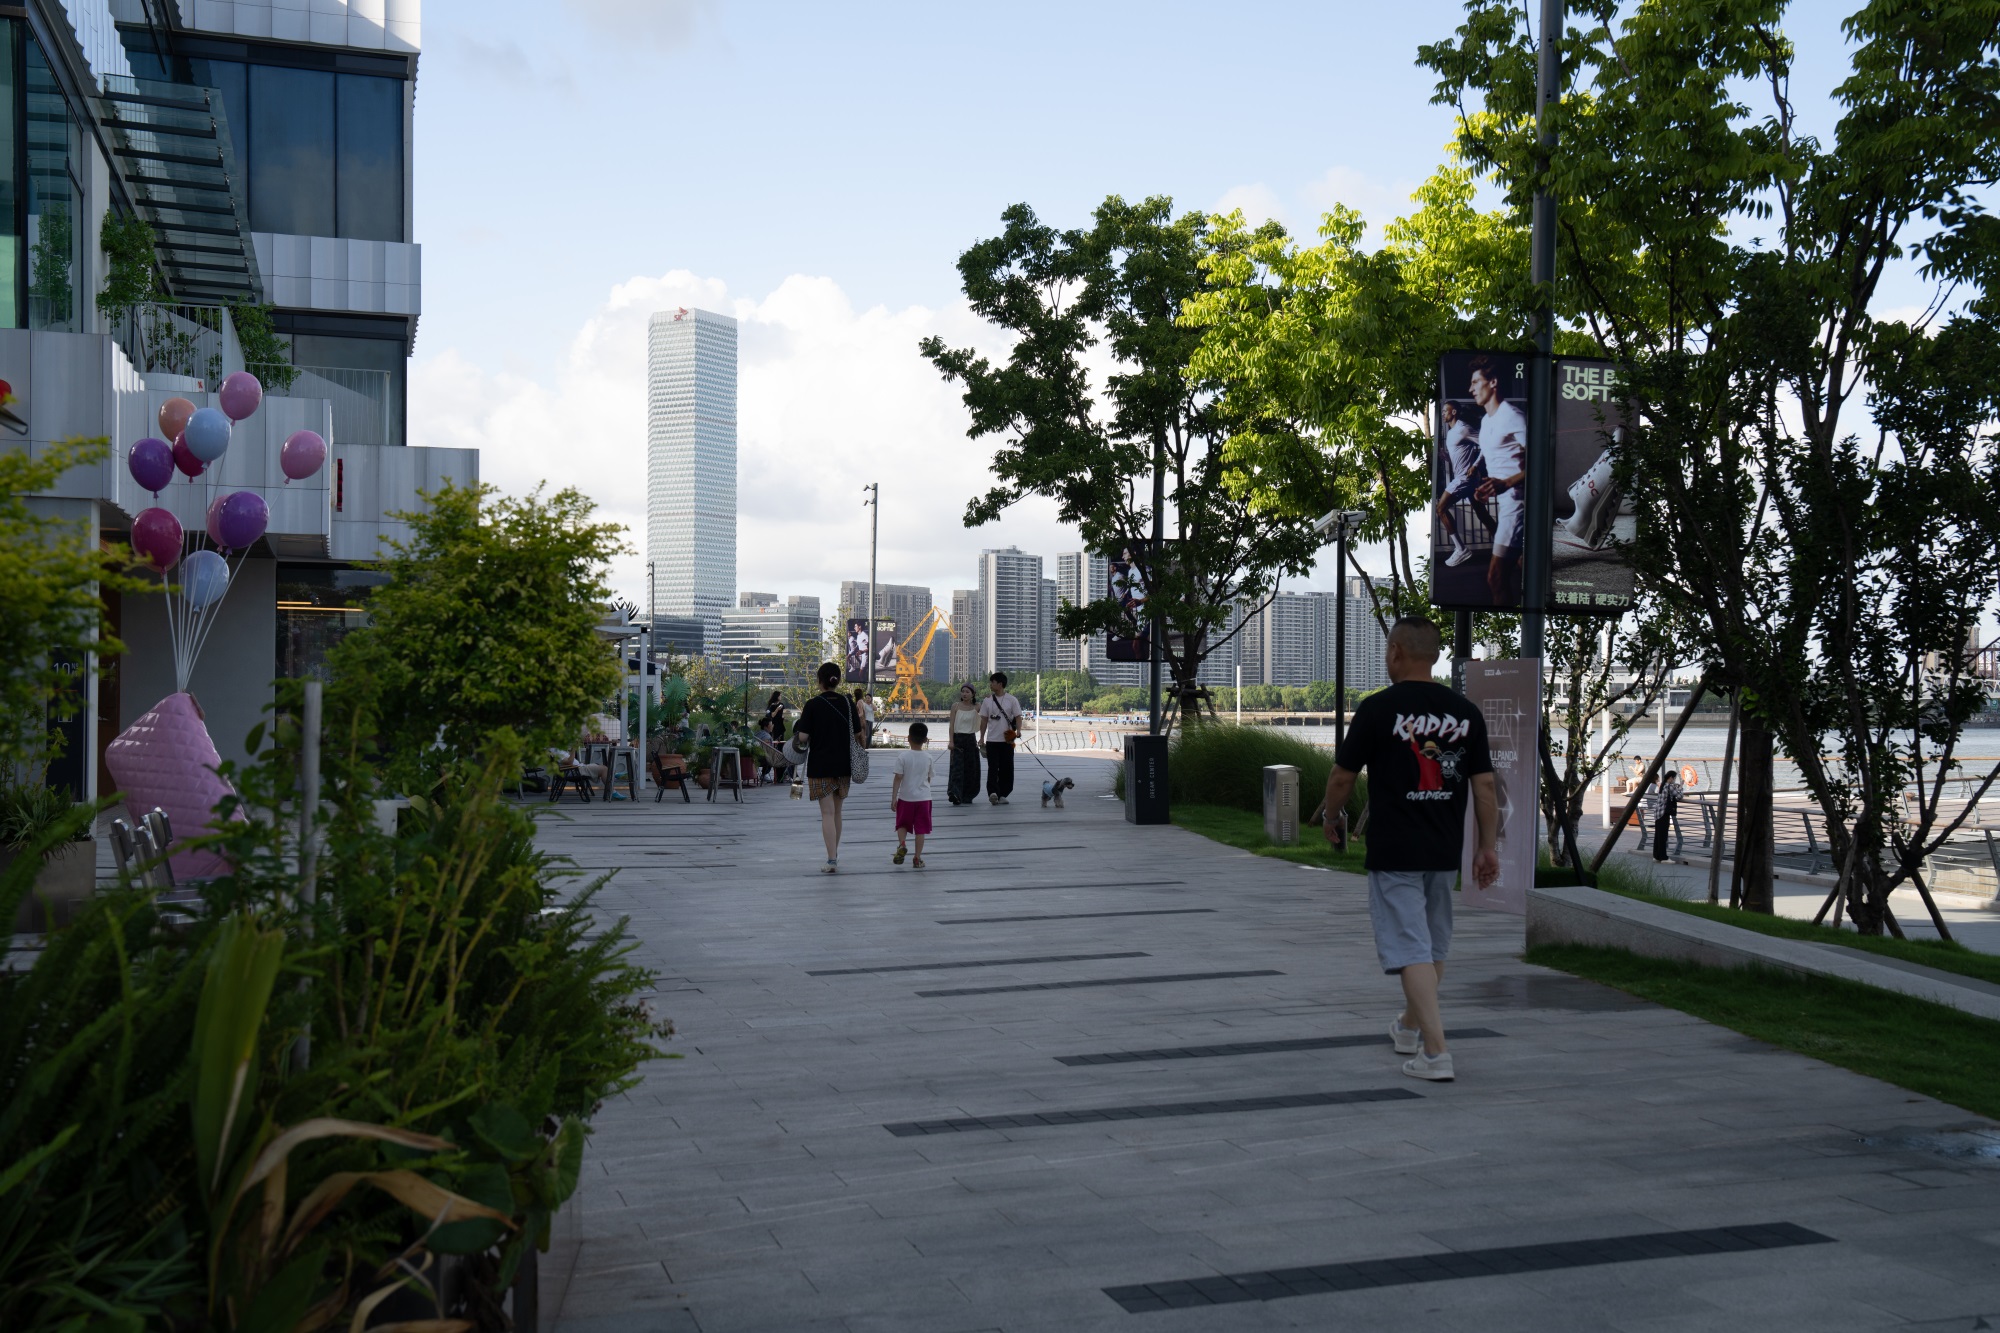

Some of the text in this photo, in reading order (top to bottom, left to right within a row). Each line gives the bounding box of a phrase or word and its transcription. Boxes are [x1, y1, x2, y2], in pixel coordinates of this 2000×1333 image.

[1562, 365, 1600, 384] THE
[1561, 382, 1623, 402] SOFT
[1555, 590, 1630, 607] 软着陆 硬实力
[1392, 712, 1470, 743] KAPPA
[1489, 750, 1518, 761] LLPANDA
